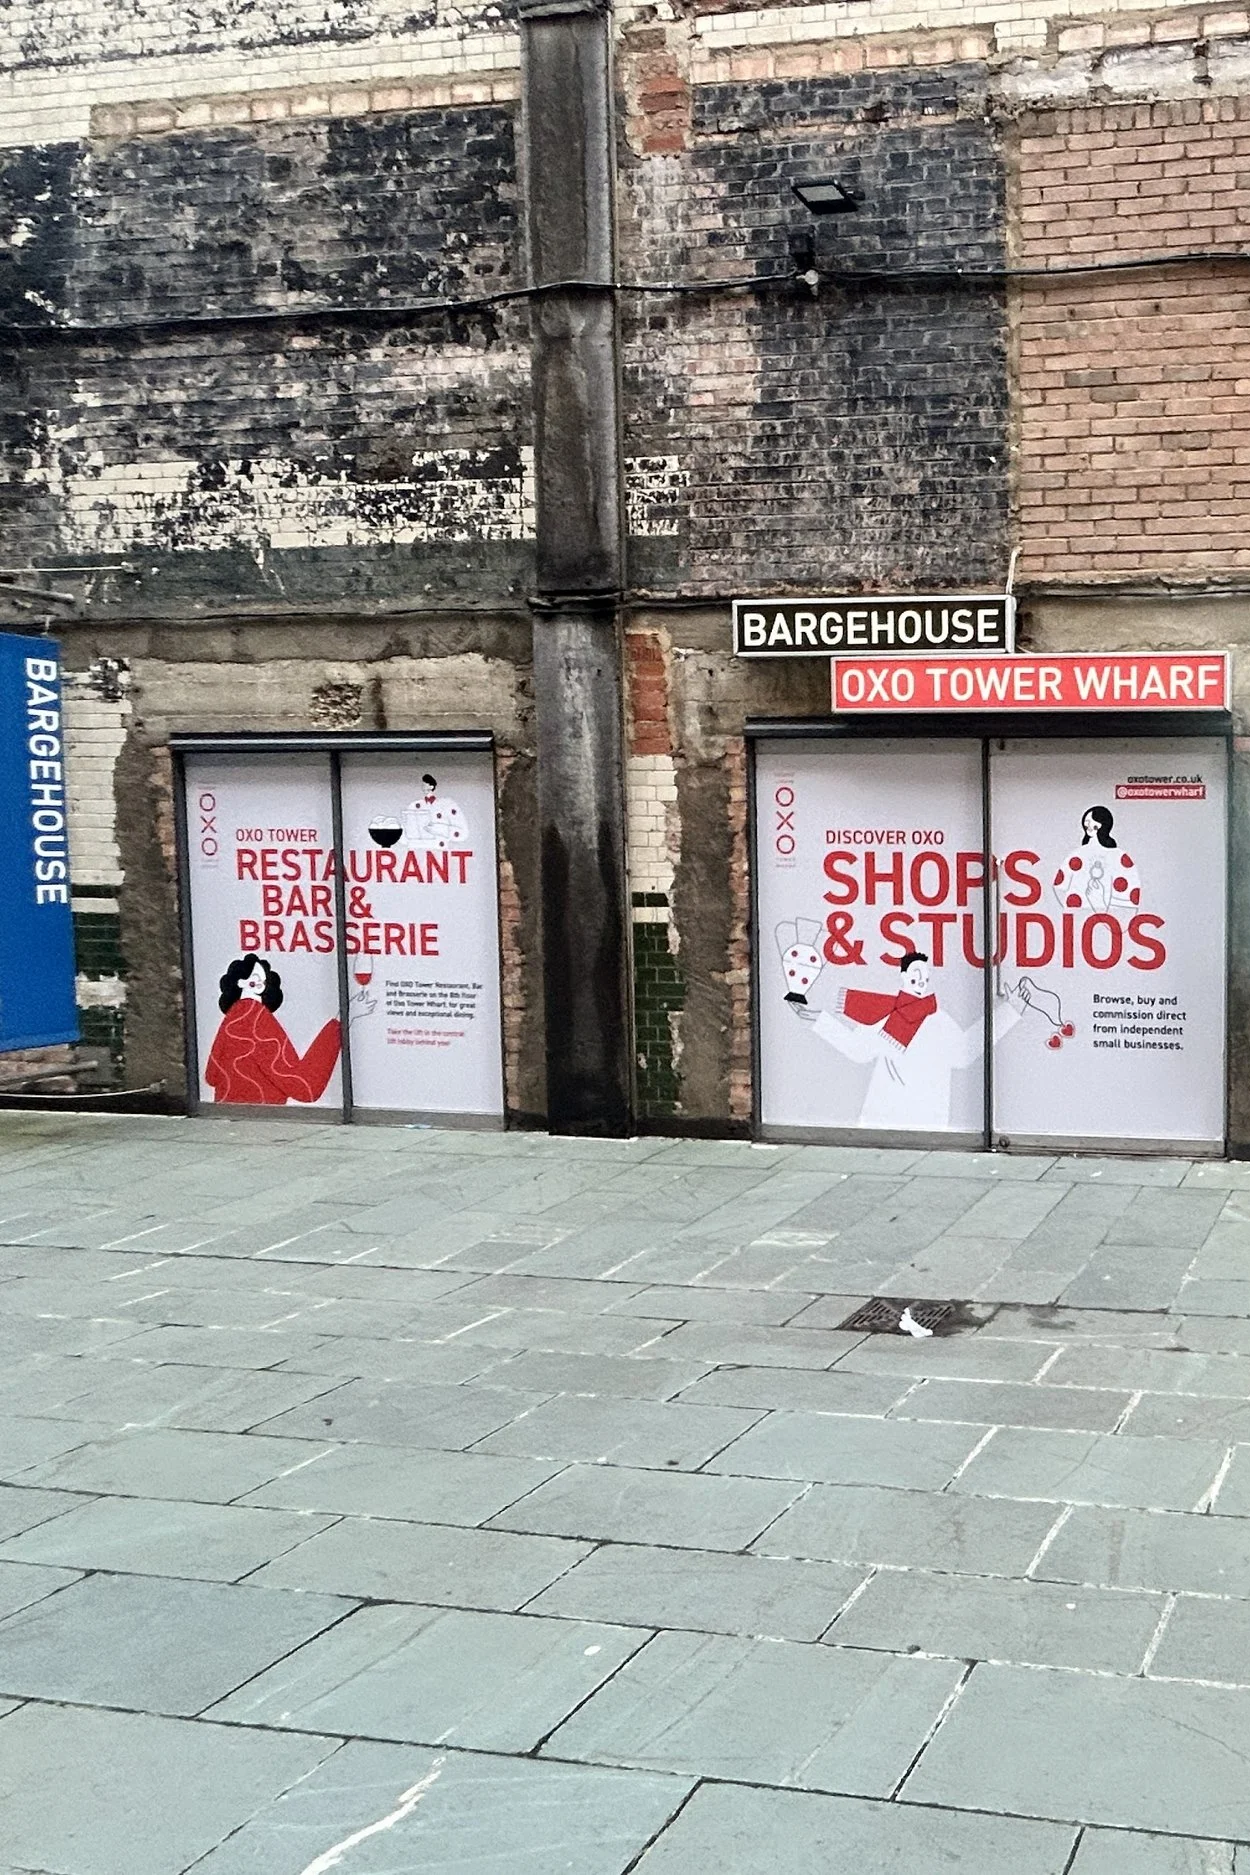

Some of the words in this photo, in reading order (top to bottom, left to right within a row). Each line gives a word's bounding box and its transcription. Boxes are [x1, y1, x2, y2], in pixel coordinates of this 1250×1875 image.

[743, 609, 1000, 647] BARGEHOUSE
[841, 667, 915, 702] OXO
[927, 666, 1062, 702] TOWER
[1074, 664, 1219, 700] WHARF
[25, 656, 68, 905] BARGEHOUSE
[1117, 786, 1204, 798] @oxotowerwharf
[1127, 774, 1203, 783] oxotower.co.uk
[236, 829, 263, 842] OXO
[269, 829, 317, 842] TOWER
[775, 786, 795, 855] OXO
[825, 830, 906, 846] DISCOVER
[911, 830, 944, 846] OXO
[236, 848, 473, 884] RESTAURANT
[822, 850, 1042, 907] SHOPS
[263, 885, 333, 917] BAR
[349, 886, 373, 919] &
[239, 920, 439, 956] BRASSERIE
[823, 911, 867, 966] &
[880, 913, 1167, 970] STUDIOS
[1093, 994, 1134, 1005] Browse,
[1137, 995, 1156, 1006] buy
[1159, 996, 1177, 1005] and
[1093, 1010, 1153, 1020] commission
[1156, 1010, 1186, 1020] direct
[1093, 1024, 1117, 1033] from
[1120, 1024, 1183, 1036] independent
[1093, 1039, 1120, 1048] small
[1124, 1040, 1183, 1050] businesses.
